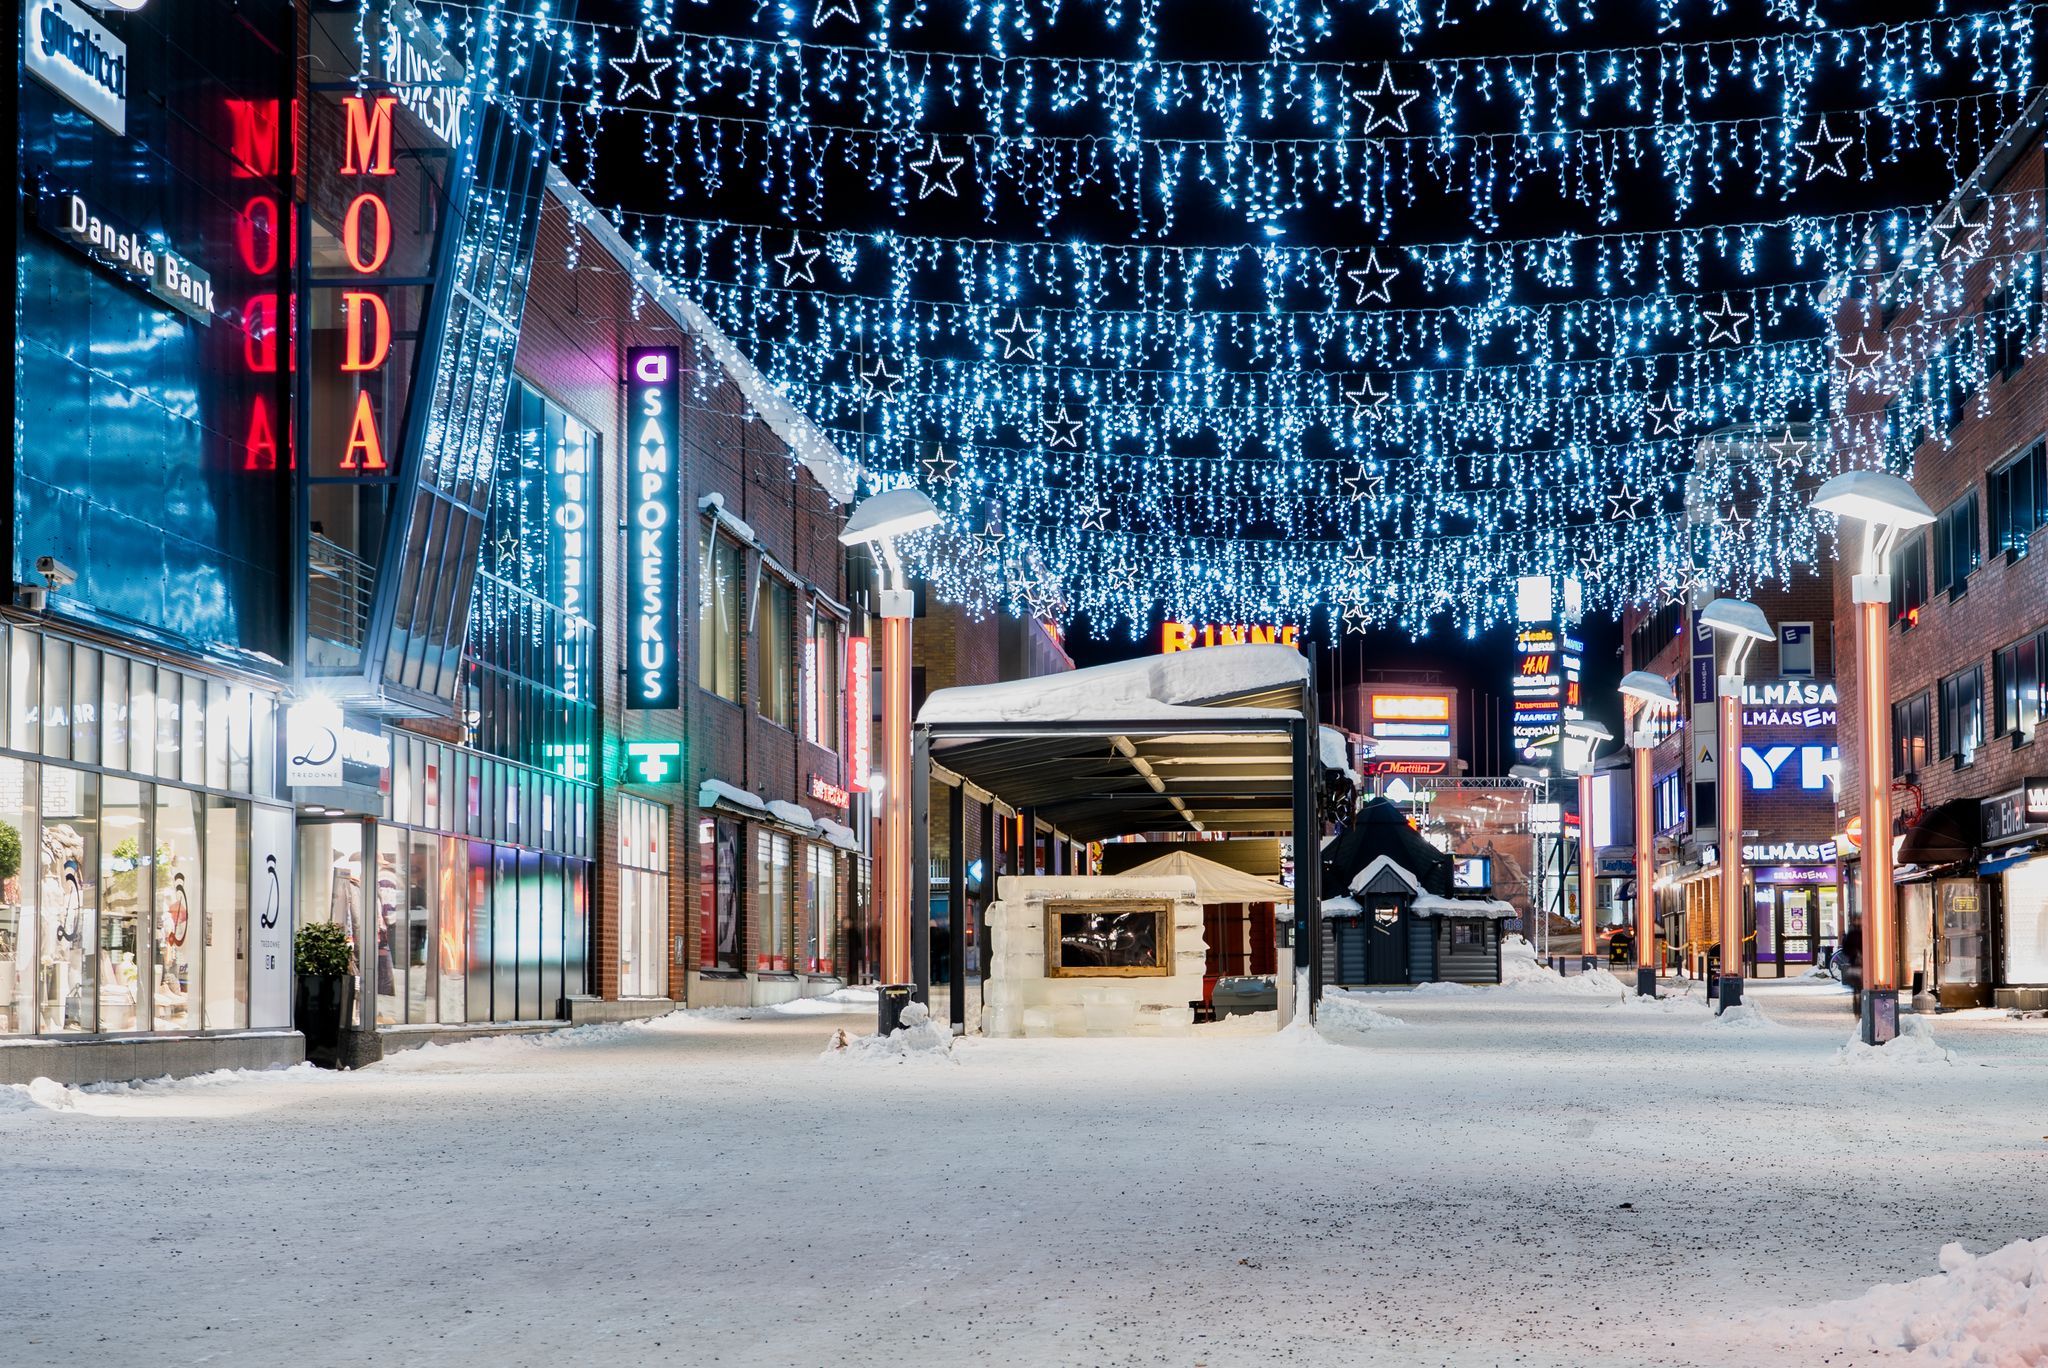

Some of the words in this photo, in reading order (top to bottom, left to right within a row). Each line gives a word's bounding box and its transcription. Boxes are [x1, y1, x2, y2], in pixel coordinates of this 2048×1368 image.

[72, 195, 155, 276] Danske
[165, 251, 215, 313] Bank
[340, 97, 398, 470] MODA
[637, 387, 667, 700] SAMPOKESKUS
[1523, 656, 1549, 675] H&M
[1515, 702, 1559, 710] Dressmann
[1513, 725, 1560, 737] KappAhl
[1388, 761, 1431, 773] Marttiini
[1773, 870, 1829, 880] SILMÄASEMA
